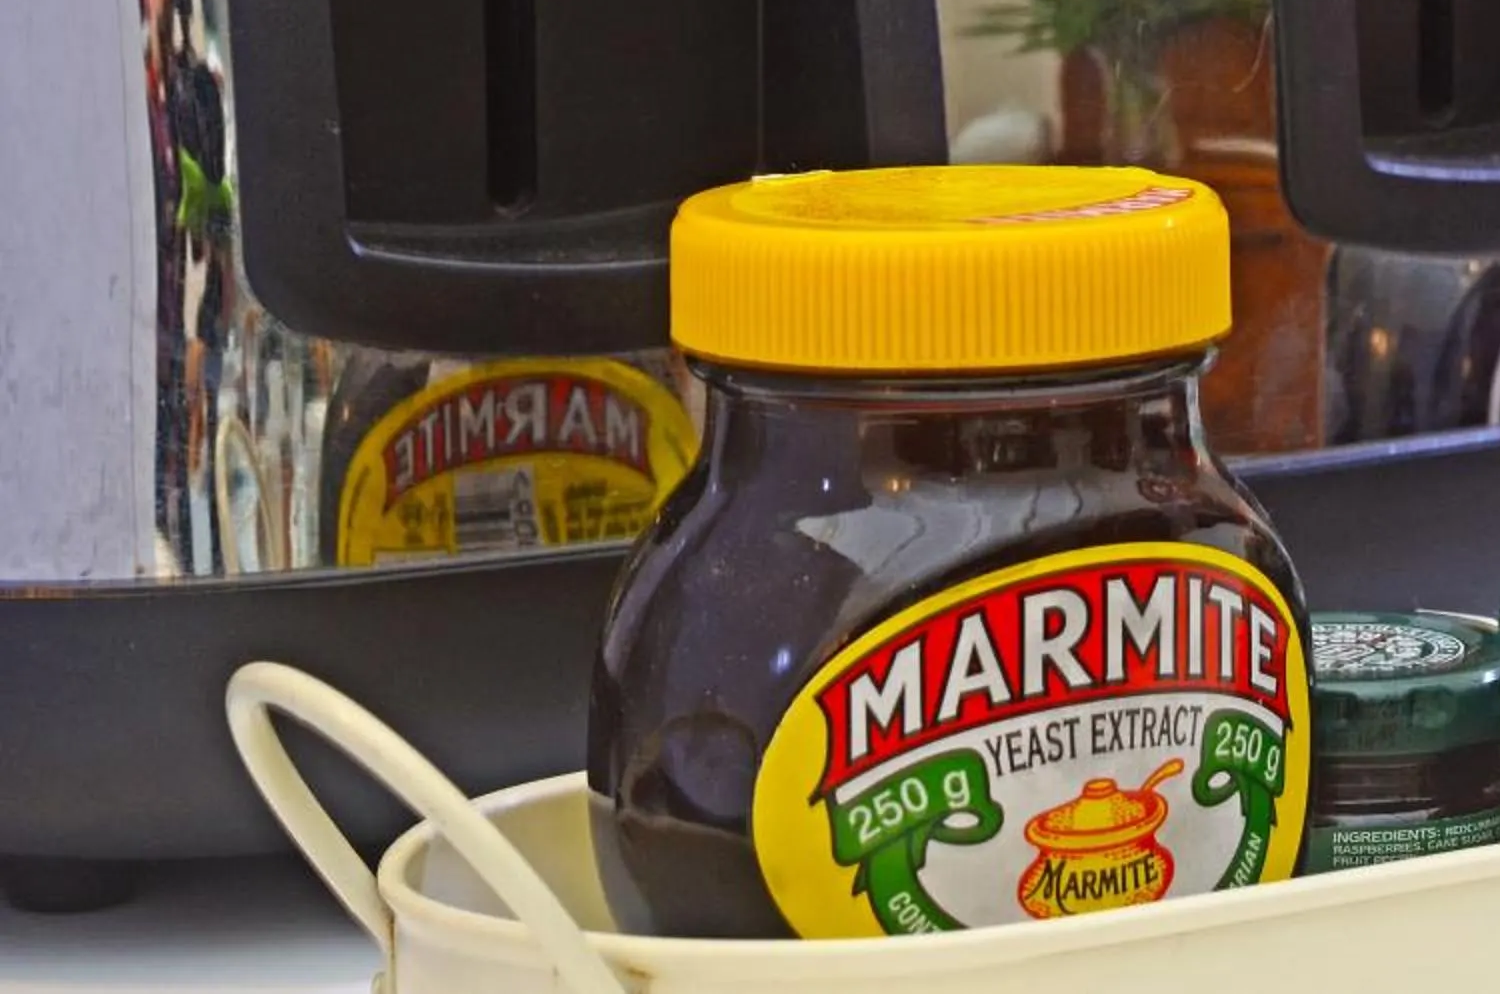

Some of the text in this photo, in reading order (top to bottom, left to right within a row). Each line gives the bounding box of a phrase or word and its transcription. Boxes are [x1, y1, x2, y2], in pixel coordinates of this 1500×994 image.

[848, 573, 1280, 762] MARMITE
[984, 705, 1203, 777] YEAST EXTRACT
[1214, 721, 1281, 782] 250 g
[848, 769, 969, 845] 250 g
[1333, 826, 1441, 844] INGREDIENTS:
[1023, 856, 1160, 906] MARMITE
[1228, 832, 1262, 889] RIAN
[888, 891, 943, 934] CON
